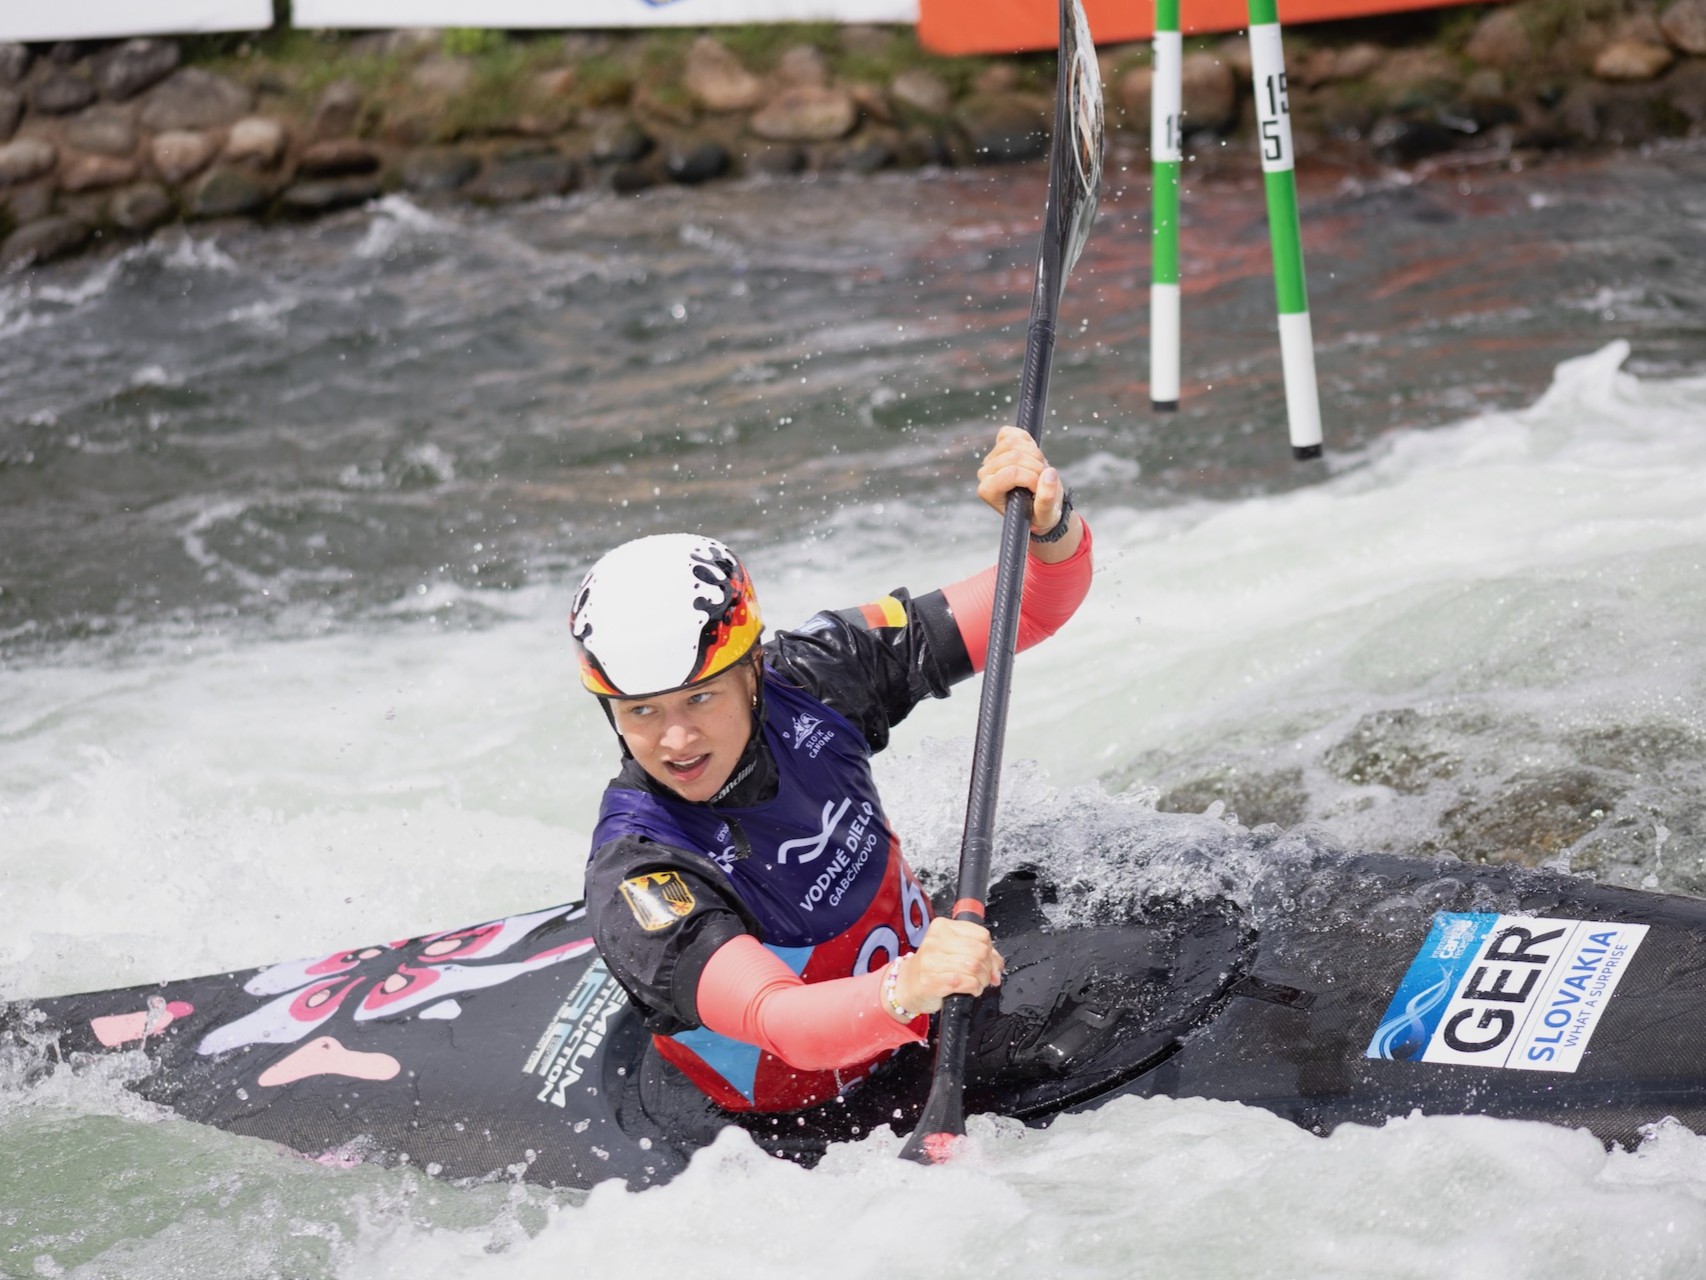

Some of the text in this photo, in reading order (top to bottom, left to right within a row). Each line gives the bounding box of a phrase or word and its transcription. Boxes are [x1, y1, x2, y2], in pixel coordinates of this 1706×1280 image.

[1262, 120, 1282, 160] 5
[799, 848, 851, 912] VODNÉ
[829, 833, 877, 906] GABČÍKOVO
[537, 976, 618, 1102] STRUCTION
[550, 982, 629, 1108] EMIUM
[1443, 925, 1567, 1053] GER
[1527, 931, 1618, 1061] SLOVAKIA
[1564, 944, 1628, 1047] WHAT A SURPRISE
